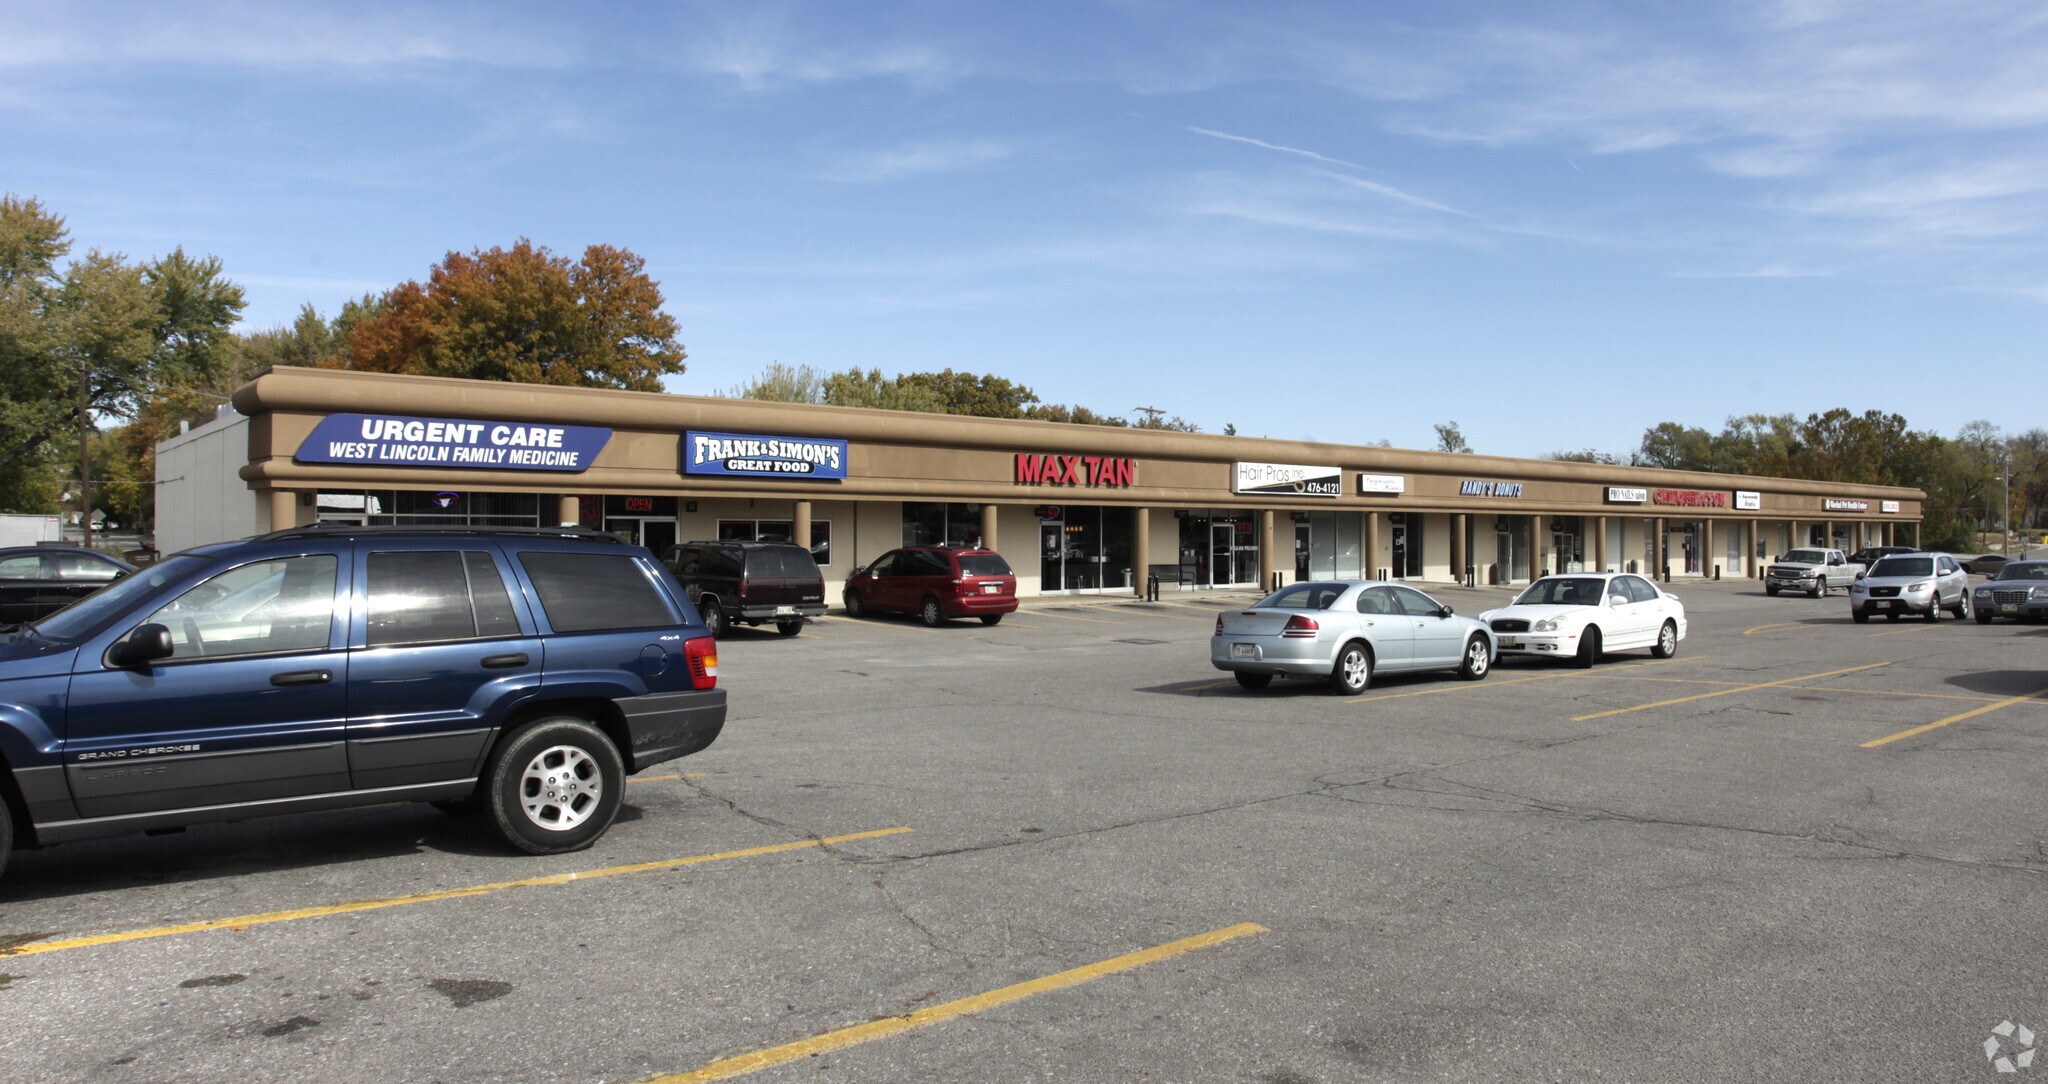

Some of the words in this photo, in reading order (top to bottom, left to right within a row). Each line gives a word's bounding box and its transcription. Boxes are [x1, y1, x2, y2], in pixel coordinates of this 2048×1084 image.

[361, 419, 484, 443] URGENT
[491, 426, 564, 447] CARE
[329, 442, 377, 459] WEST
[380, 444, 451, 461] LINCOLN
[453, 447, 506, 463] FAMILY
[509, 449, 578, 466] MEDICINE
[728, 460, 772, 471] GREAT
[774, 461, 810, 472] FOOD
[1017, 453, 1080, 483] MAX
[1084, 456, 1133, 485] TAN
[1240, 464, 1262, 480] Hair
[1267, 465, 1289, 481] Pros
[1307, 482, 1339, 493] 476-4121
[1461, 481, 1493, 495] RANDY'S
[1495, 483, 1522, 496] DONUTS
[1610, 489, 1620, 500] PRO
[1621, 489, 1634, 500] NAILS
[626, 498, 652, 510] OPEN
[78, 750, 127, 760] GRAND
[131, 744, 200, 756] CHEROKEE
